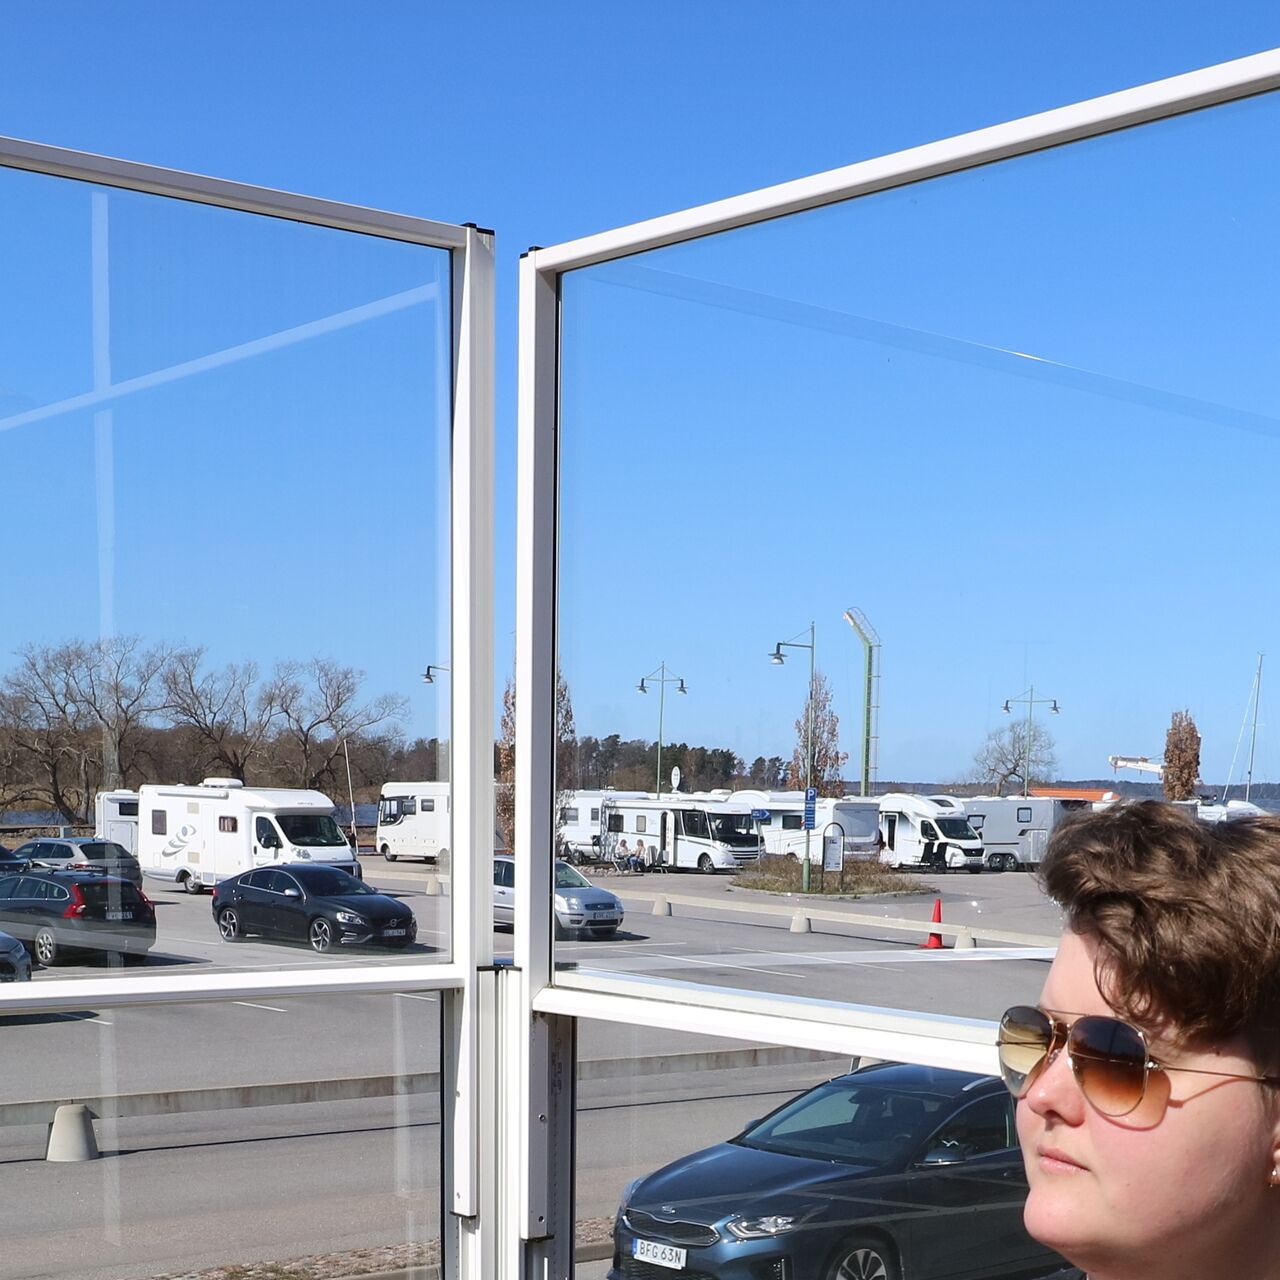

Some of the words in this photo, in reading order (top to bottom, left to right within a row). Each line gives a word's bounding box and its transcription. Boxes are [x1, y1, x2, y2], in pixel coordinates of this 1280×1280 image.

[808, 789, 815, 800] P
[640, 1242, 659, 1258] BFG
[661, 1248, 682, 1264] 63N
